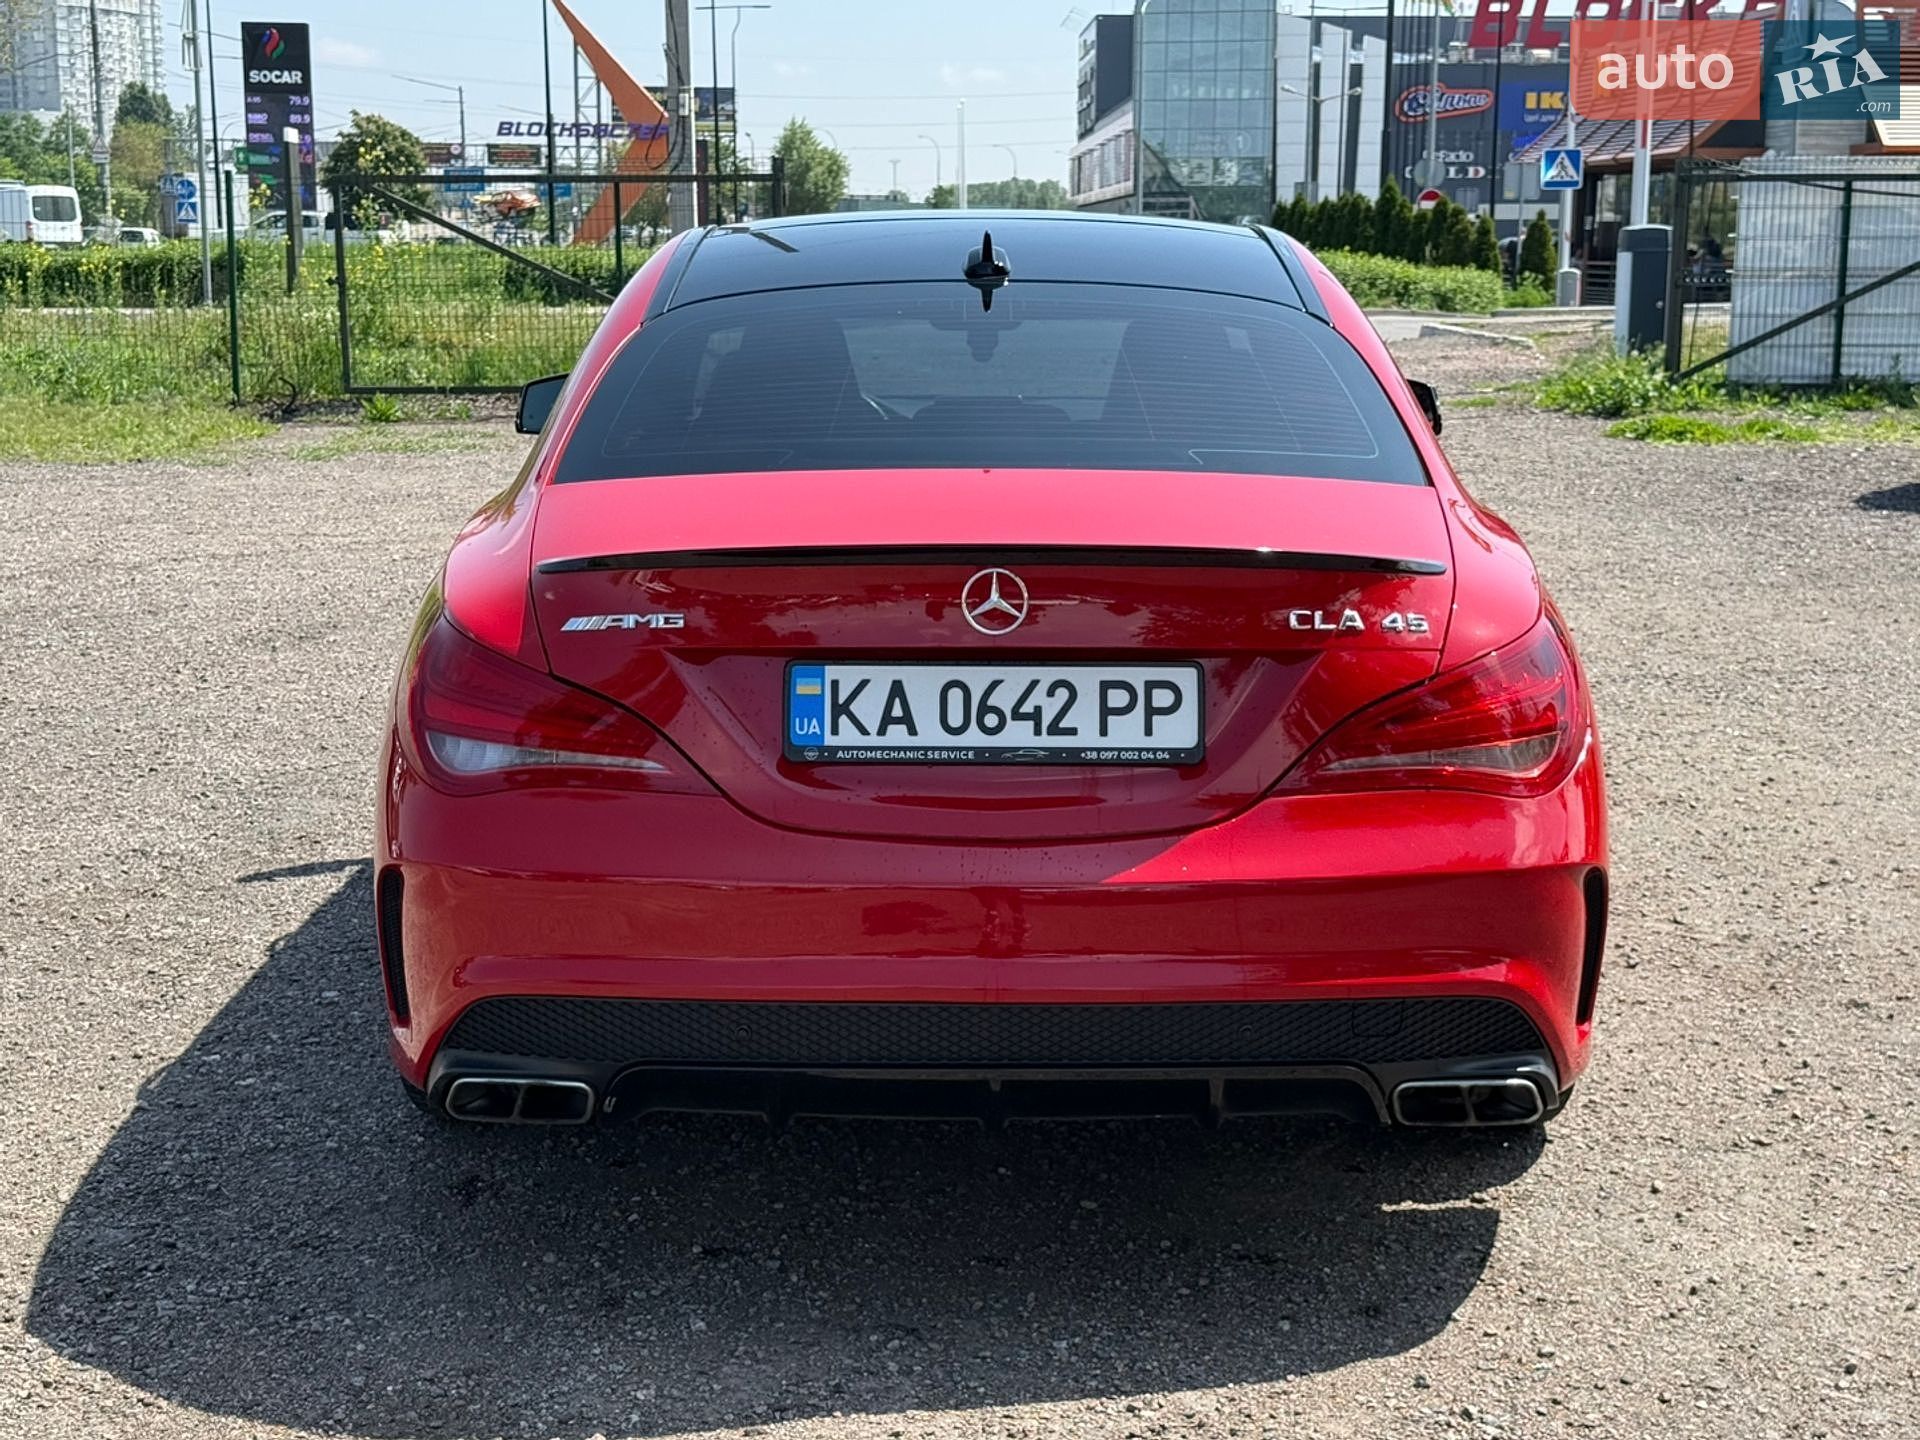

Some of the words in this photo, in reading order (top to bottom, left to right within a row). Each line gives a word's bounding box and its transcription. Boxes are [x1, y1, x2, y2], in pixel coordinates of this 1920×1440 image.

[249, 70, 303, 84] SOCAR
[599, 613, 685, 630] AMG
[1289, 608, 1365, 631] CLA
[1381, 611, 1430, 633] 45
[830, 678, 919, 737] KA
[938, 678, 1079, 737] 0642
[1098, 679, 1184, 738] PP
[795, 717, 821, 736] UA
[836, 750, 925, 760] AUTOMECHANIC
[926, 750, 975, 760] SERVICE
[1080, 751, 1098, 760] +38
[1099, 751, 1118, 760] 097
[1120, 751, 1139, 760] 002
[1141, 751, 1154, 760] 04
[1156, 751, 1170, 760] 04
